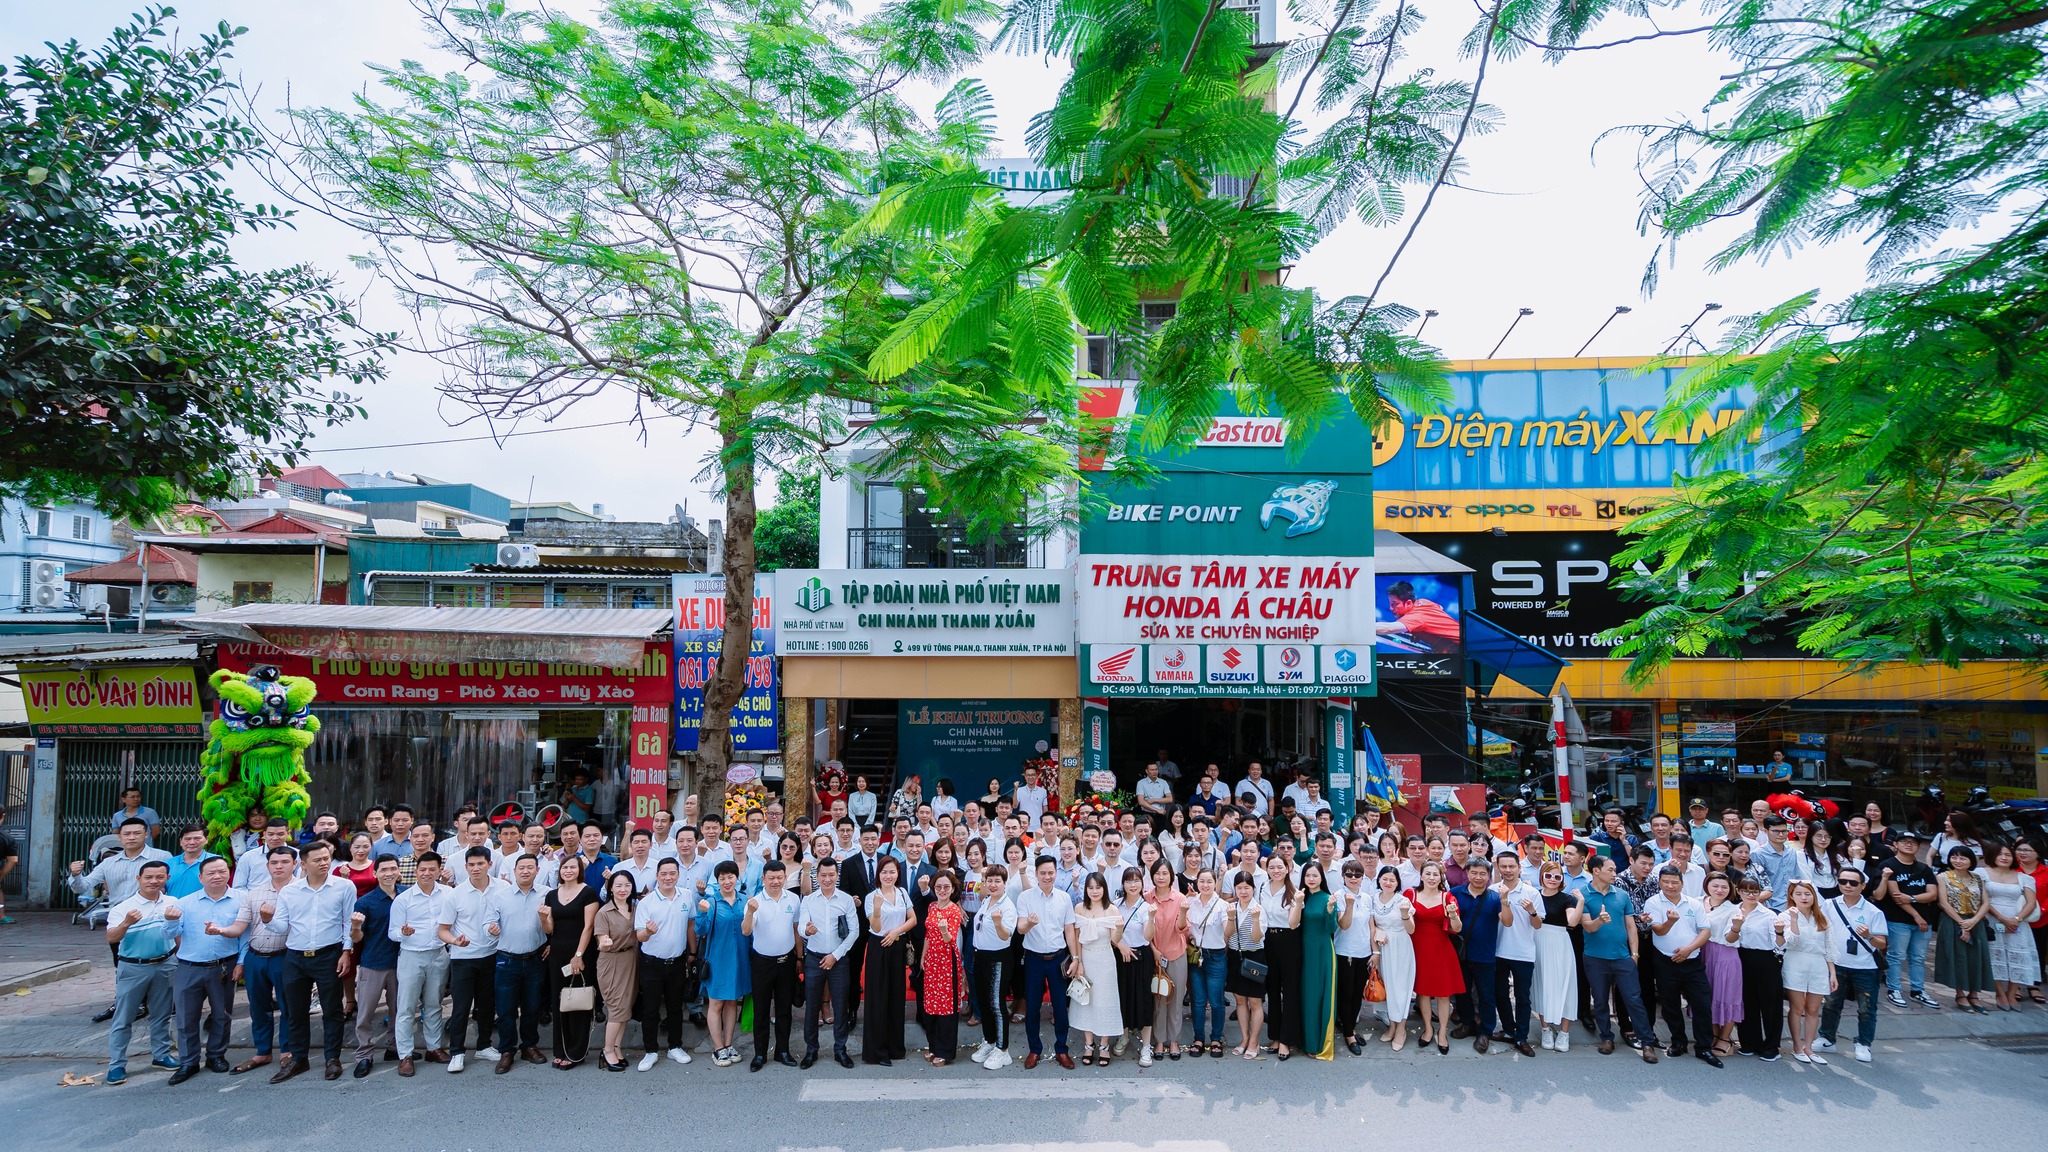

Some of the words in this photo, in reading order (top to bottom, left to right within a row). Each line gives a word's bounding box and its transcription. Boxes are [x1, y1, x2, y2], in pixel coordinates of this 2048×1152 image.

[988, 166, 1020, 196] IỆT
[1203, 420, 1285, 443] Castrol
[1412, 411, 1517, 457] Điện
[1107, 504, 1163, 522] BIKE
[1168, 505, 1241, 523] POINT
[1386, 505, 1450, 518] SONY
[1466, 504, 1534, 517] oppo
[1547, 505, 1582, 517] TCL
[1091, 564, 1181, 588] TRUNG
[1191, 561, 1248, 588] TÂM
[1256, 566, 1291, 589] XE
[1300, 562, 1360, 589] MÁY
[842, 580, 869, 609] TẬP
[873, 580, 914, 605] ĐOÀN
[918, 580, 950, 605] NHÀ
[954, 576, 989, 605] PHỐ
[989, 580, 1020, 608] VIỆT
[1026, 584, 1061, 605] NAM
[678, 598, 700, 630] XE
[705, 598, 727, 630] DU
[752, 596, 771, 629] CH
[1124, 595, 1221, 619] HONDA
[1231, 591, 1251, 619] Á
[1260, 591, 1333, 620] CHÂU
[1491, 601, 1534, 610] POWERED
[1535, 601, 1547, 609] BY
[784, 619, 798, 629] NHÀ
[800, 619, 814, 630] PHỐ
[814, 620, 828, 630] VIỆT
[858, 614, 882, 629] CHI
[886, 607, 937, 629] NHÁNH
[941, 614, 990, 629] THANH
[994, 610, 1036, 629] XUÂN
[1140, 622, 1170, 639] SỬA
[1175, 625, 1194, 638] XE
[1201, 623, 1261, 639] CHUYÊN
[1265, 625, 1320, 642] NGHIỆP
[1553, 632, 1574, 647] VŨ
[1580, 632, 1624, 647] TÔNG
[684, 641, 703, 652] XE
[707, 638, 723, 652] SÂ
[751, 641, 765, 652] AY
[786, 640, 820, 650] HOTLINE
[827, 640, 846, 650] 1900
[848, 640, 869, 650] 0266
[908, 644, 921, 652] 499
[922, 643, 932, 652] VŨ
[934, 642, 952, 652] TÔNG
[984, 644, 1007, 652] THANH
[1008, 642, 1030, 652] XUÂN,
[1032, 644, 1042, 652] TP
[1042, 642, 1052, 652] HÀ
[1054, 643, 1066, 653] NỘI
[1155, 671, 1194, 681] YAMAHA
[1210, 672, 1255, 681] SUZUKI
[1278, 671, 1303, 680] SYM
[1324, 675, 1366, 683] PIAGGIO
[27, 681, 60, 713] VỊT
[65, 675, 91, 708] CỎ
[96, 676, 137, 708] VÂN
[142, 676, 193, 707] ĐÌNH
[344, 684, 388, 698] Cơm
[392, 684, 439, 700] Rang
[460, 684, 496, 698] Phở
[502, 685, 540, 698] Xào
[560, 685, 590, 700] Mỳ
[598, 684, 634, 698] Xào
[1102, 685, 1118, 694] ĐC:
[1119, 685, 1136, 694] 499
[1136, 685, 1148, 694] Vũ
[1149, 685, 1171, 695] Tông
[1172, 685, 1197, 695] Phan,
[1198, 685, 1225, 694] Thanh
[1226, 686, 1251, 695] Xuân,
[1253, 686, 1265, 694] Hà
[1266, 686, 1281, 696] Nội
[1288, 686, 1302, 694] ĐT:
[1303, 686, 1324, 694] 0977
[1326, 686, 1342, 694] 789
[1343, 686, 1358, 694] 911
[752, 691, 771, 712] CHỖ
[632, 705, 650, 723] Cơm
[650, 706, 668, 724] Rang
[692, 718, 700, 728] xe
[729, 716, 738, 728] nh
[908, 706, 930, 724] LỄ
[932, 711, 973, 725] KHAI
[975, 710, 1044, 725] TRƯƠNG
[100, 725, 119, 734] Phan
[126, 725, 148, 734] Thanh
[948, 728, 966, 737] CHI
[968, 727, 1004, 737] NHÁNH
[1092, 724, 1100, 748] Castrol
[1336, 723, 1344, 748] Castrol
[638, 732, 662, 756] Gà
[958, 738, 977, 746] XUÂN
[1008, 738, 1018, 746] TRÌ
[38, 760, 54, 769] 495
[1062, 758, 1078, 767] 499
[630, 768, 648, 785] Cơm
[649, 768, 667, 786] Rang
[636, 794, 660, 818] Bò
